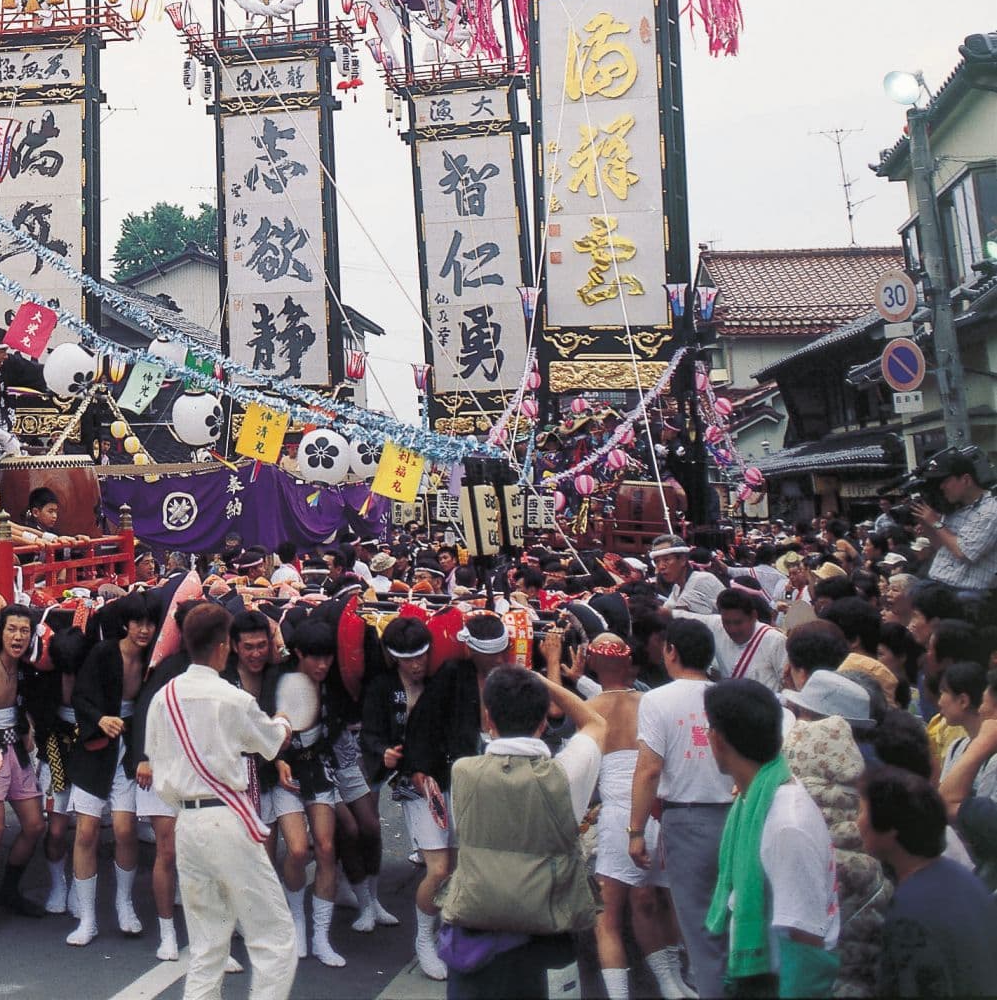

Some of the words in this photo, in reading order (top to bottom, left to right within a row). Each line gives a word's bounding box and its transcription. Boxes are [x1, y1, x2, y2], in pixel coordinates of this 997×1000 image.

[430, 95, 495, 123] 大漁
[439, 150, 504, 382] 智仁勇
[883, 284, 907, 308] 30
[225, 474, 245, 519] 奉納
